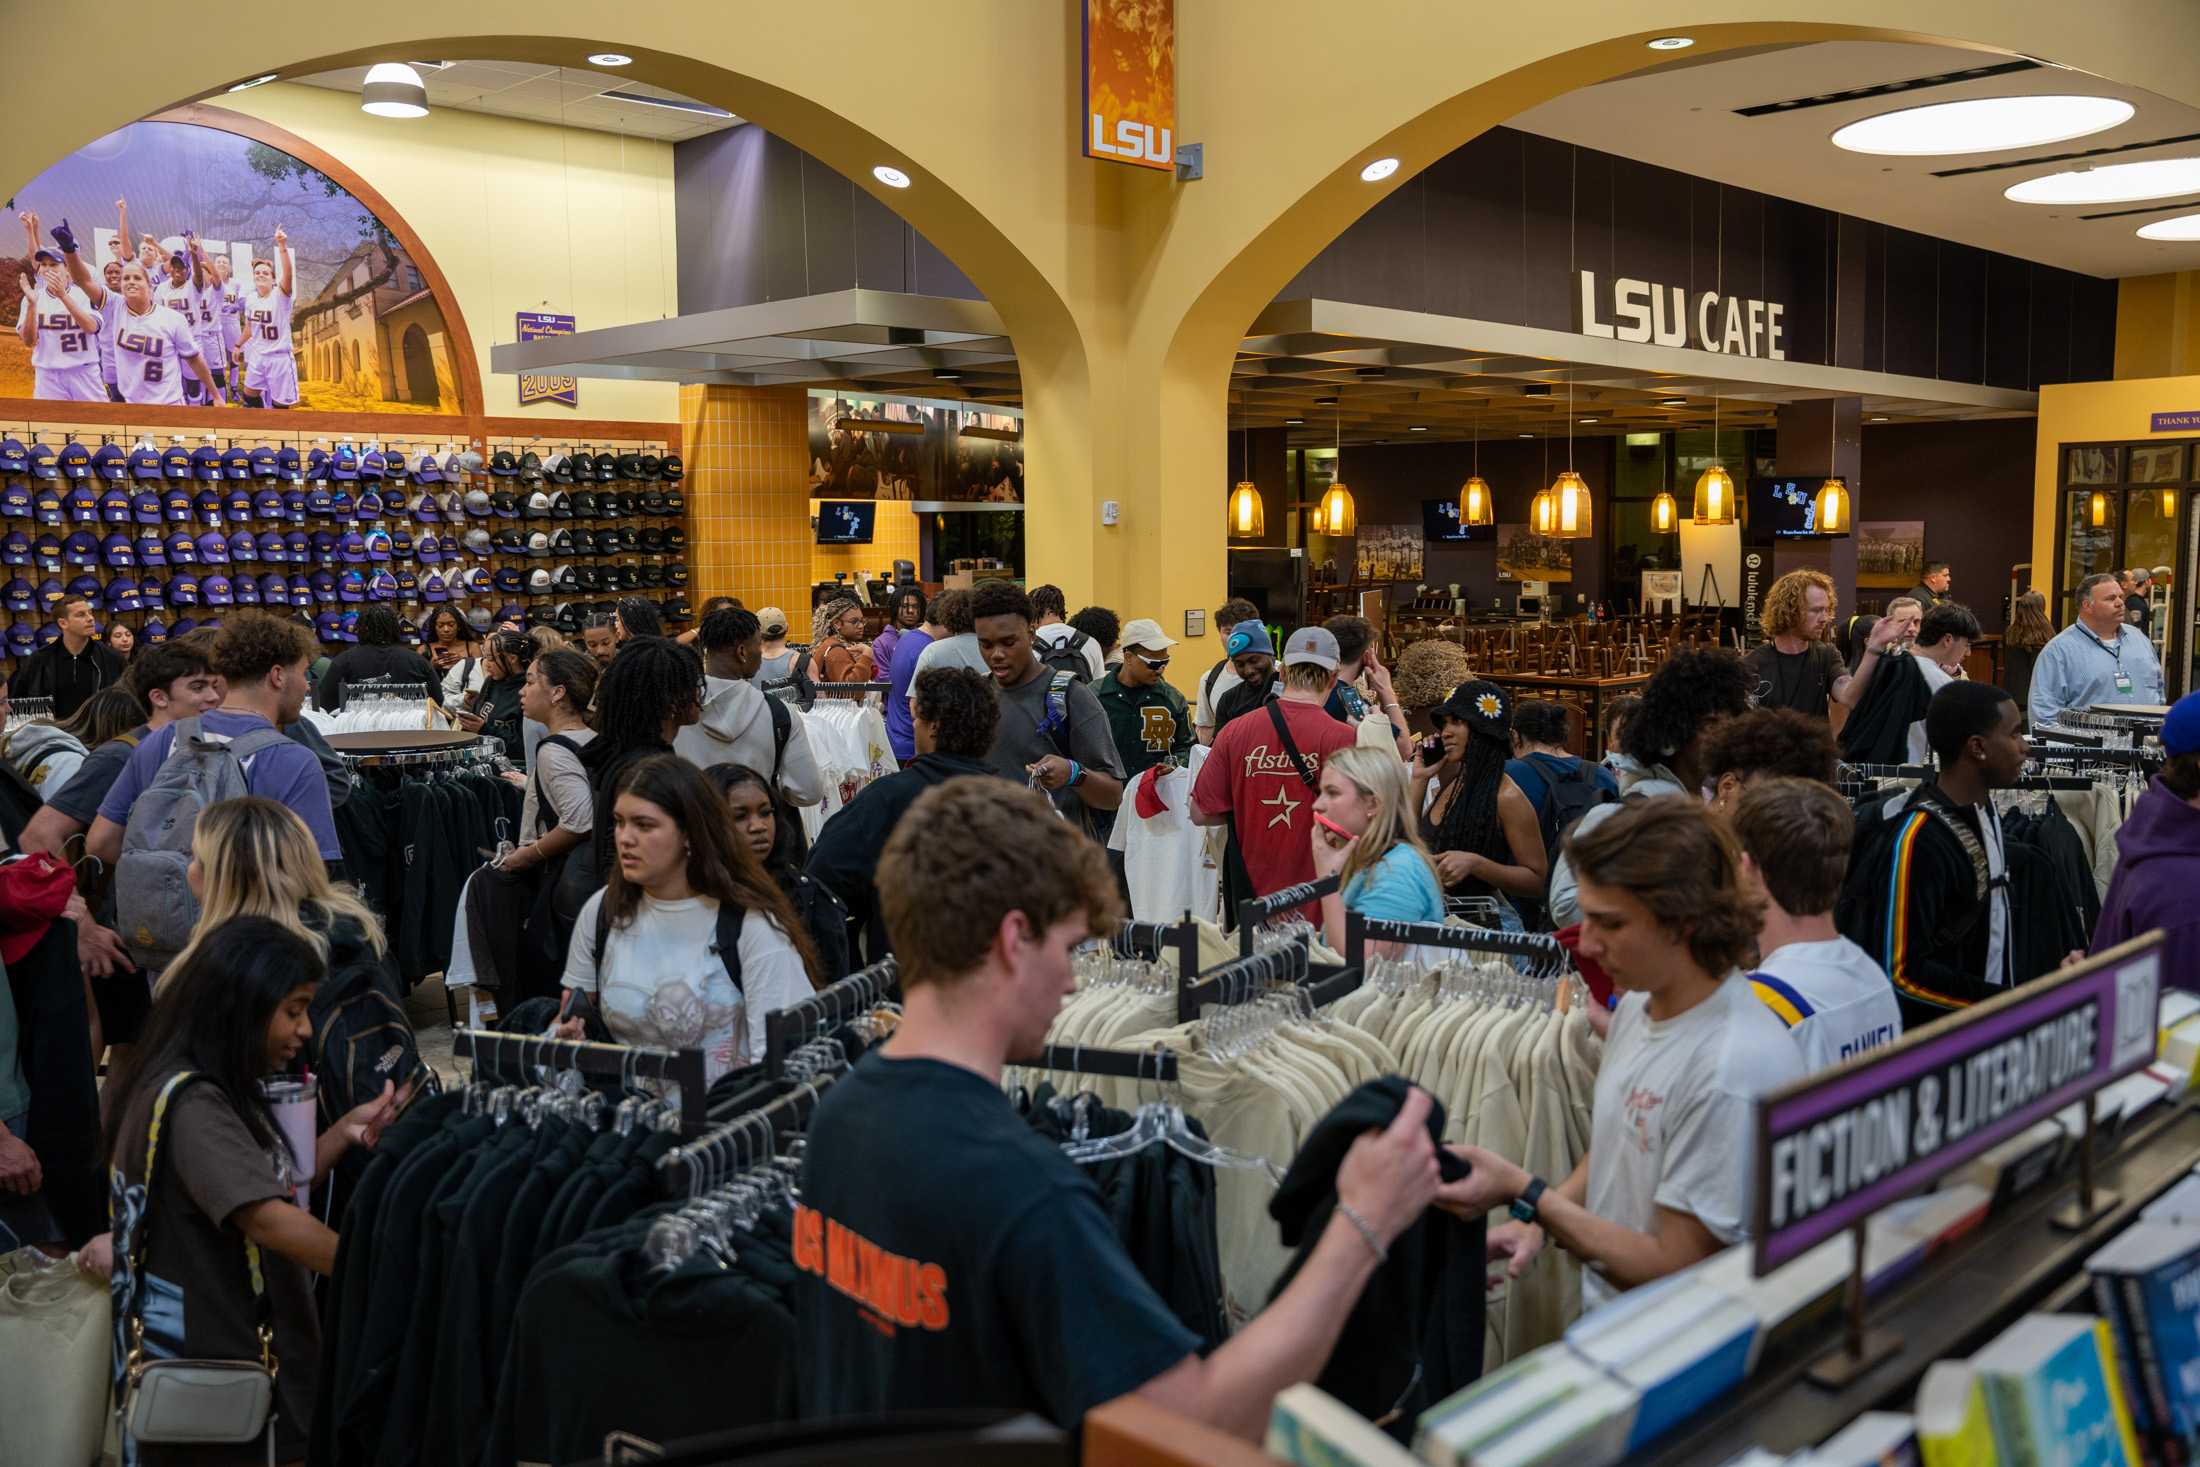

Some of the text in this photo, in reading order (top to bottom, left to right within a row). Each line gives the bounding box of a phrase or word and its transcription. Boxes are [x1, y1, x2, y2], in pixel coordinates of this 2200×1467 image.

[1093, 113, 1171, 163] LSU
[538, 315, 556, 324] LSU
[1581, 270, 1785, 361] LSU CAFE
[60, 332, 89, 352] 21
[117, 328, 165, 357] LSU
[260, 325, 279, 340] 10
[143, 361, 163, 383] 6
[2158, 417, 2190, 425] THANK
[1747, 571, 1760, 625] lululem
[1770, 1086, 1911, 1229] FICTION
[1913, 1075, 1943, 1156] &
[1946, 1001, 2098, 1141] LITERATURE
